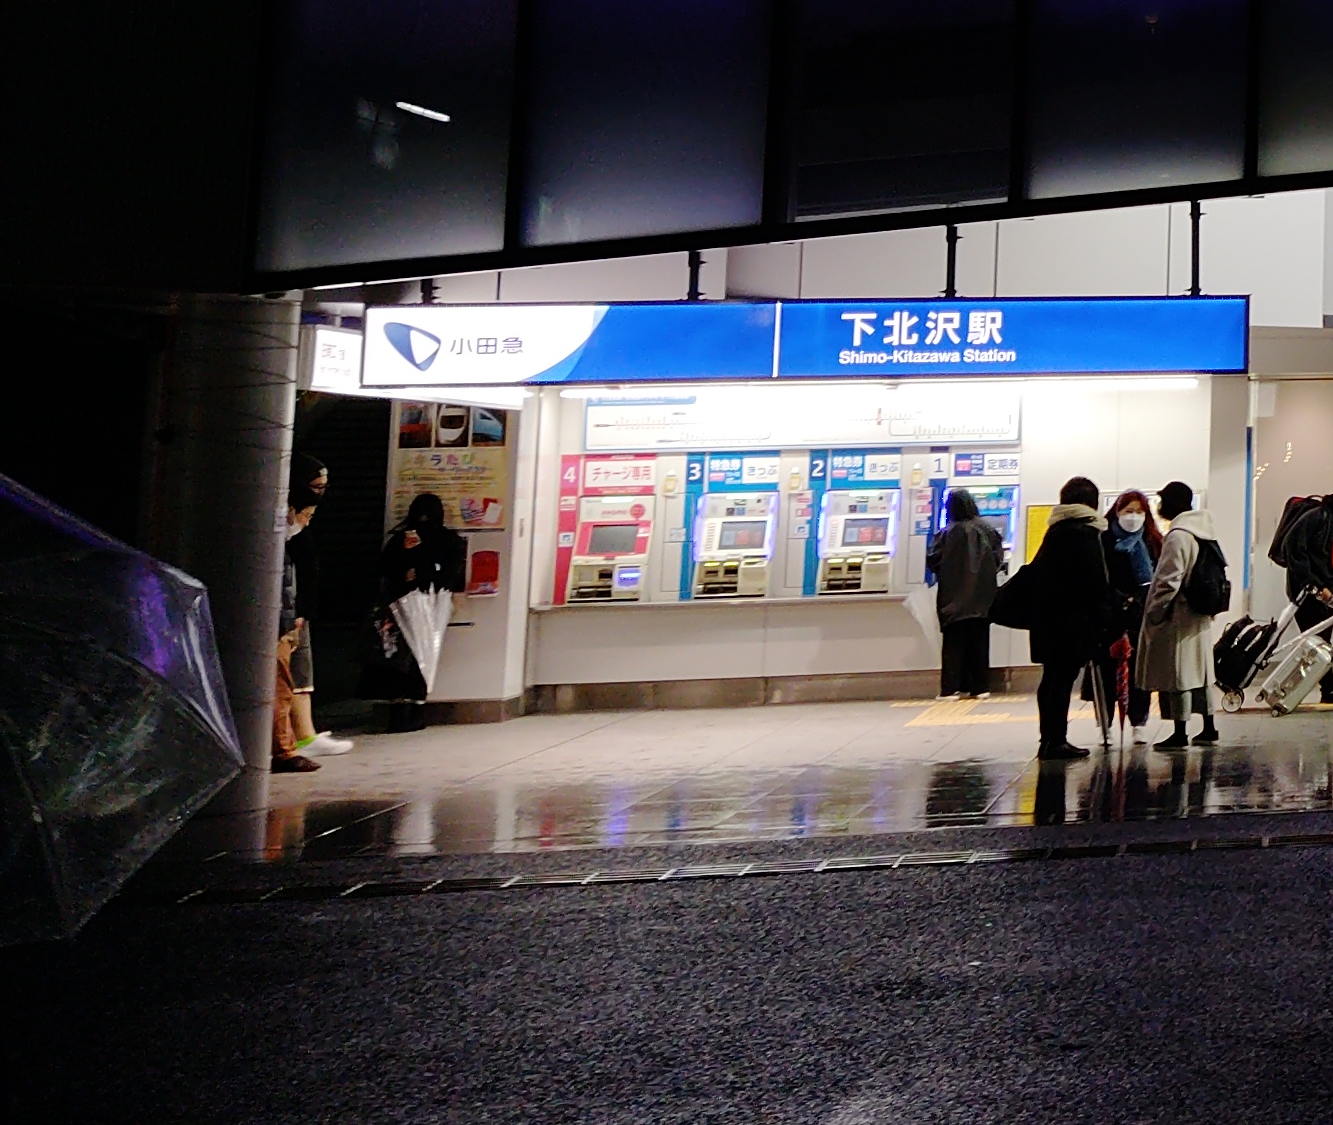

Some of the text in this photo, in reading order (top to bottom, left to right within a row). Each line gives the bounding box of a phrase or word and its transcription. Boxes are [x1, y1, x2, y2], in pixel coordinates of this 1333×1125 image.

[840, 310, 1003, 347] 下北沢駅
[450, 336, 524, 355] 小田急
[838, 348, 1017, 365] Shimo-Kitazawa Station
[688, 463, 701, 481] 3
[811, 459, 825, 478] 2
[933, 457, 944, 473] 1
[563, 466, 577, 484] 4
